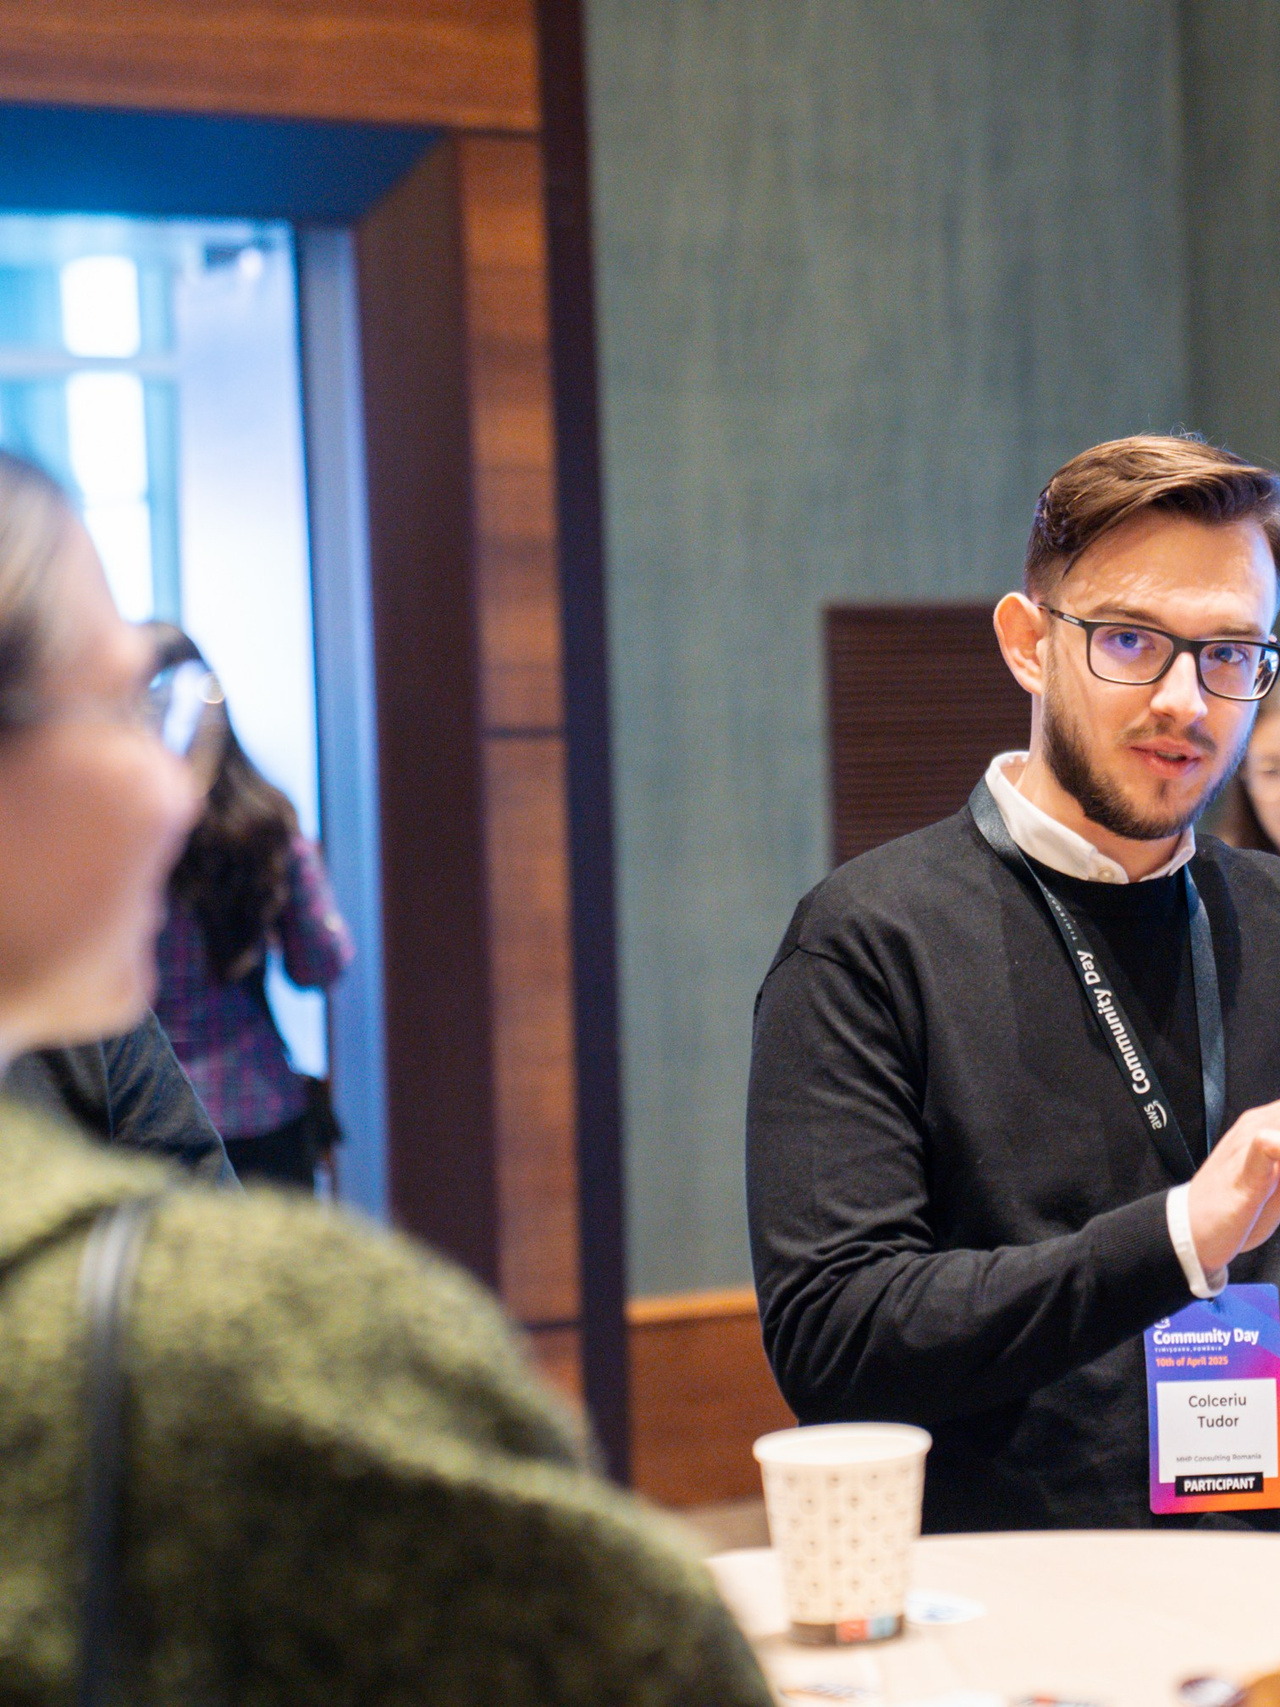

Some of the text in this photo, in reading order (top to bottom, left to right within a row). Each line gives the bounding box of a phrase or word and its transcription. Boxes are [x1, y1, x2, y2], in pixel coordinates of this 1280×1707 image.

[1077, 950, 1101, 986] Day
[1093, 988, 1151, 1095] Community
[1143, 1100, 1167, 1130] aws
[1153, 1327, 1259, 1346] Community Day
[1156, 1355, 1229, 1368] 10th of April 2025
[1188, 1393, 1247, 1408] Colceriu
[1197, 1415, 1239, 1428] Tudor
[1194, 1454, 1230, 1462] Consulting
[1183, 1476, 1256, 1492] PARTICIPANT
